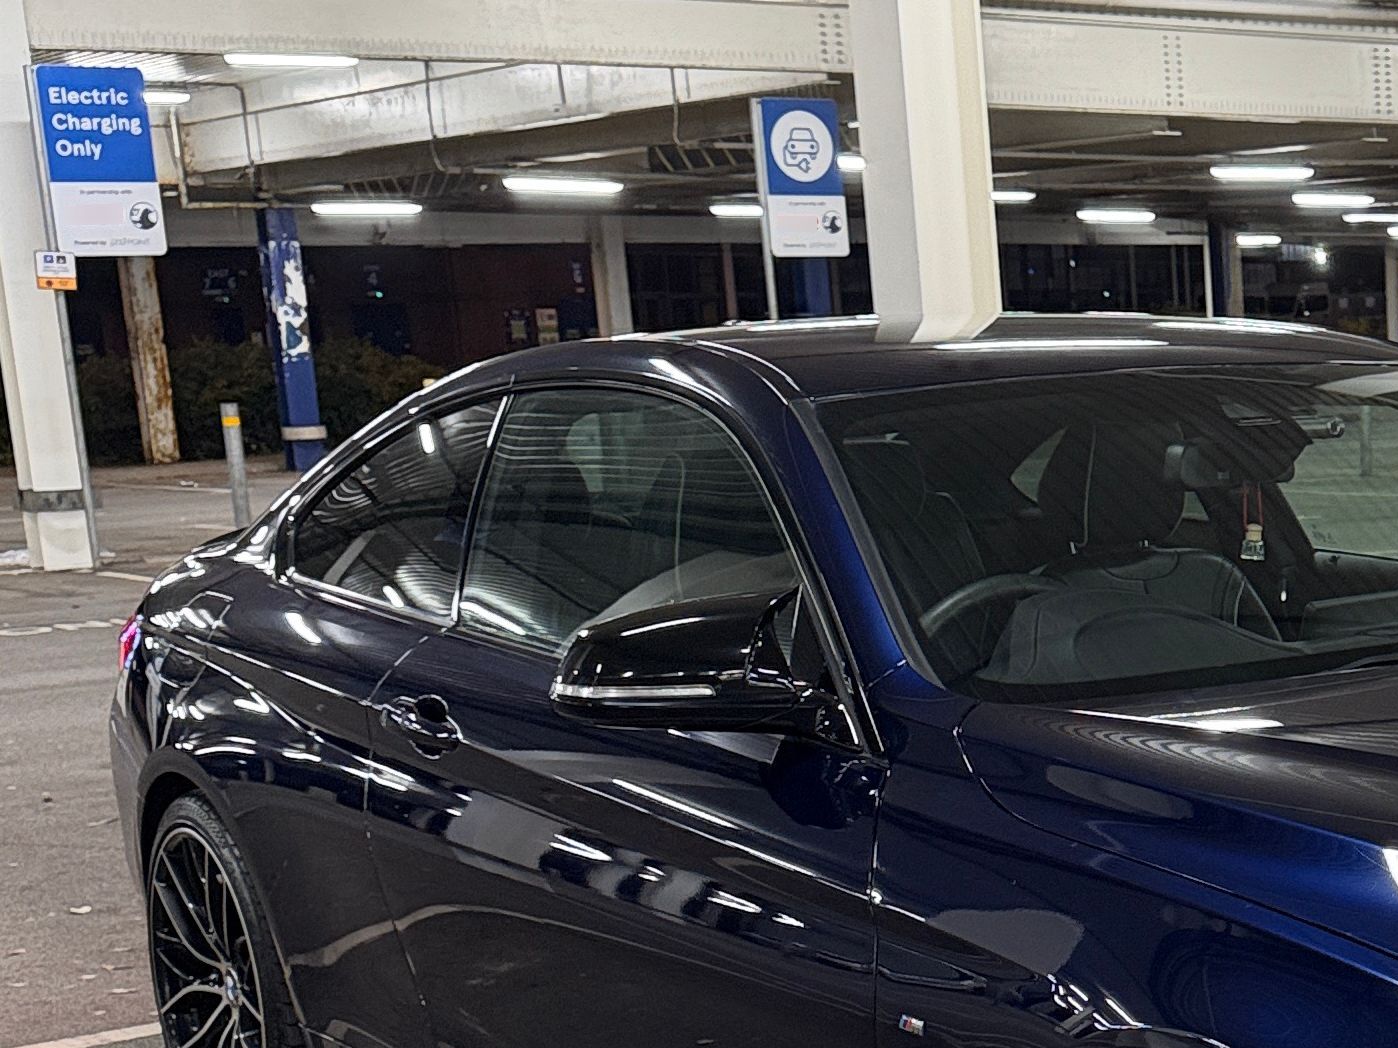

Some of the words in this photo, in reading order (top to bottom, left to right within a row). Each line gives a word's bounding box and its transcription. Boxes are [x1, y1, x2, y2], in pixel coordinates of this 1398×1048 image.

[48, 86, 129, 106] Electric
[51, 112, 142, 136] Charging
[55, 139, 102, 161] Only
